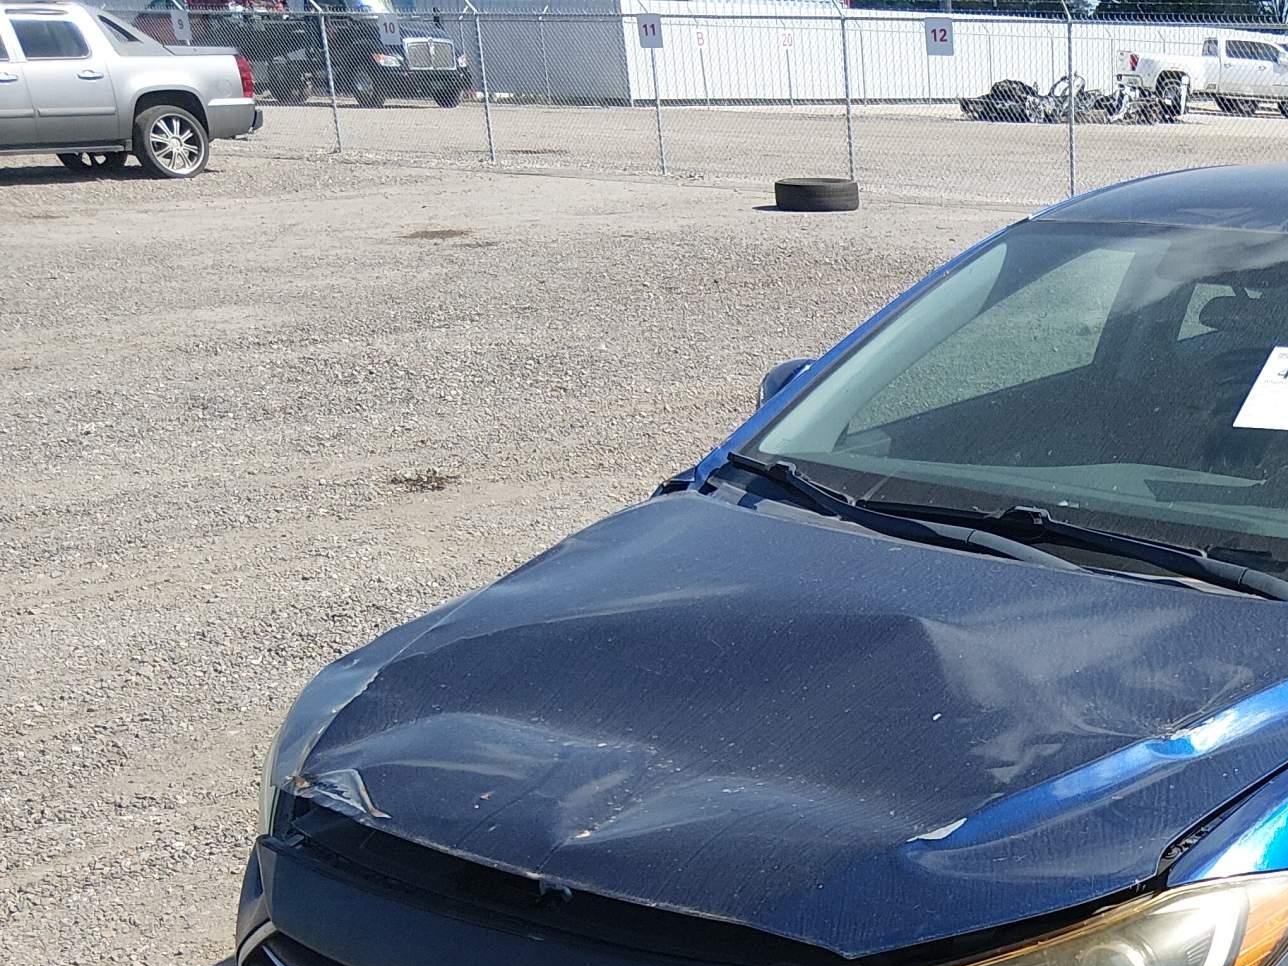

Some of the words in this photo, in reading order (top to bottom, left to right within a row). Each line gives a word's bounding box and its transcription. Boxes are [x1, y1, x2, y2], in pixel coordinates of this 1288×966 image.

[383, 22, 395, 34] 10
[643, 23, 656, 36] 11
[931, 28, 948, 42] 12
